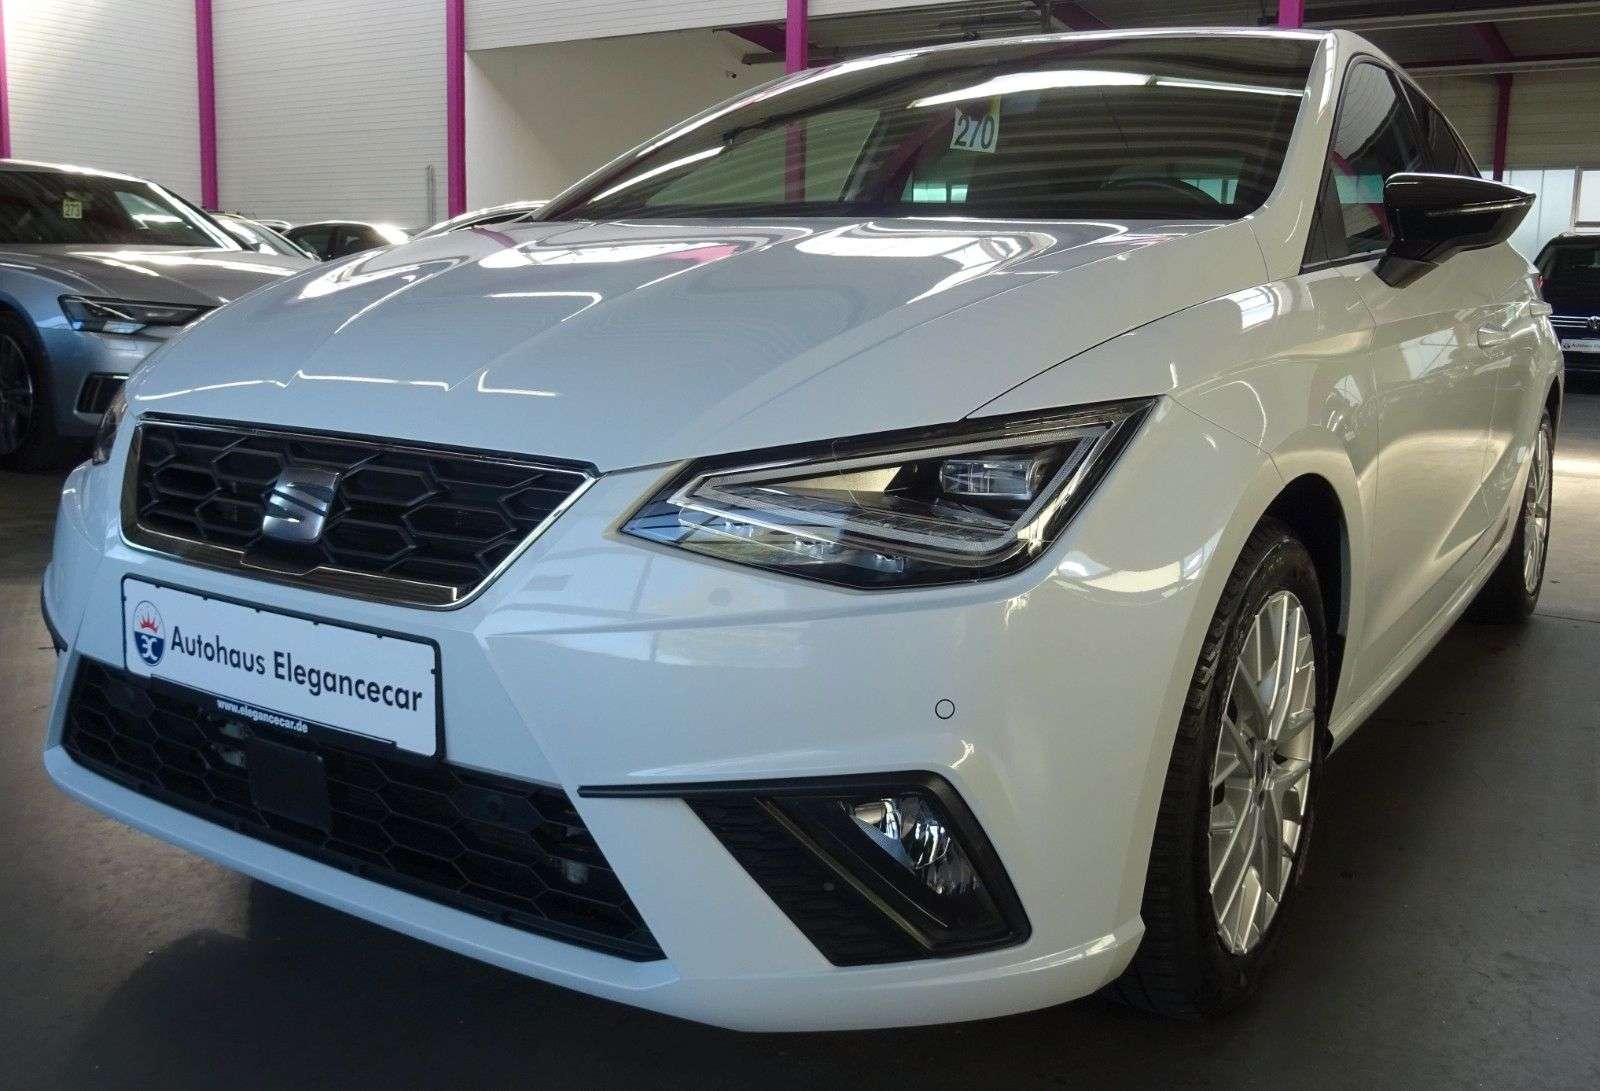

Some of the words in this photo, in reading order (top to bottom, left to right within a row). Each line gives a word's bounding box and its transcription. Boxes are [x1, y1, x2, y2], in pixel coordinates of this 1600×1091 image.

[954, 112, 995, 149] 270
[170, 625, 267, 675] Autohaus
[273, 650, 423, 711] Elegancecar
[216, 699, 308, 733] www.elegancecar.de
